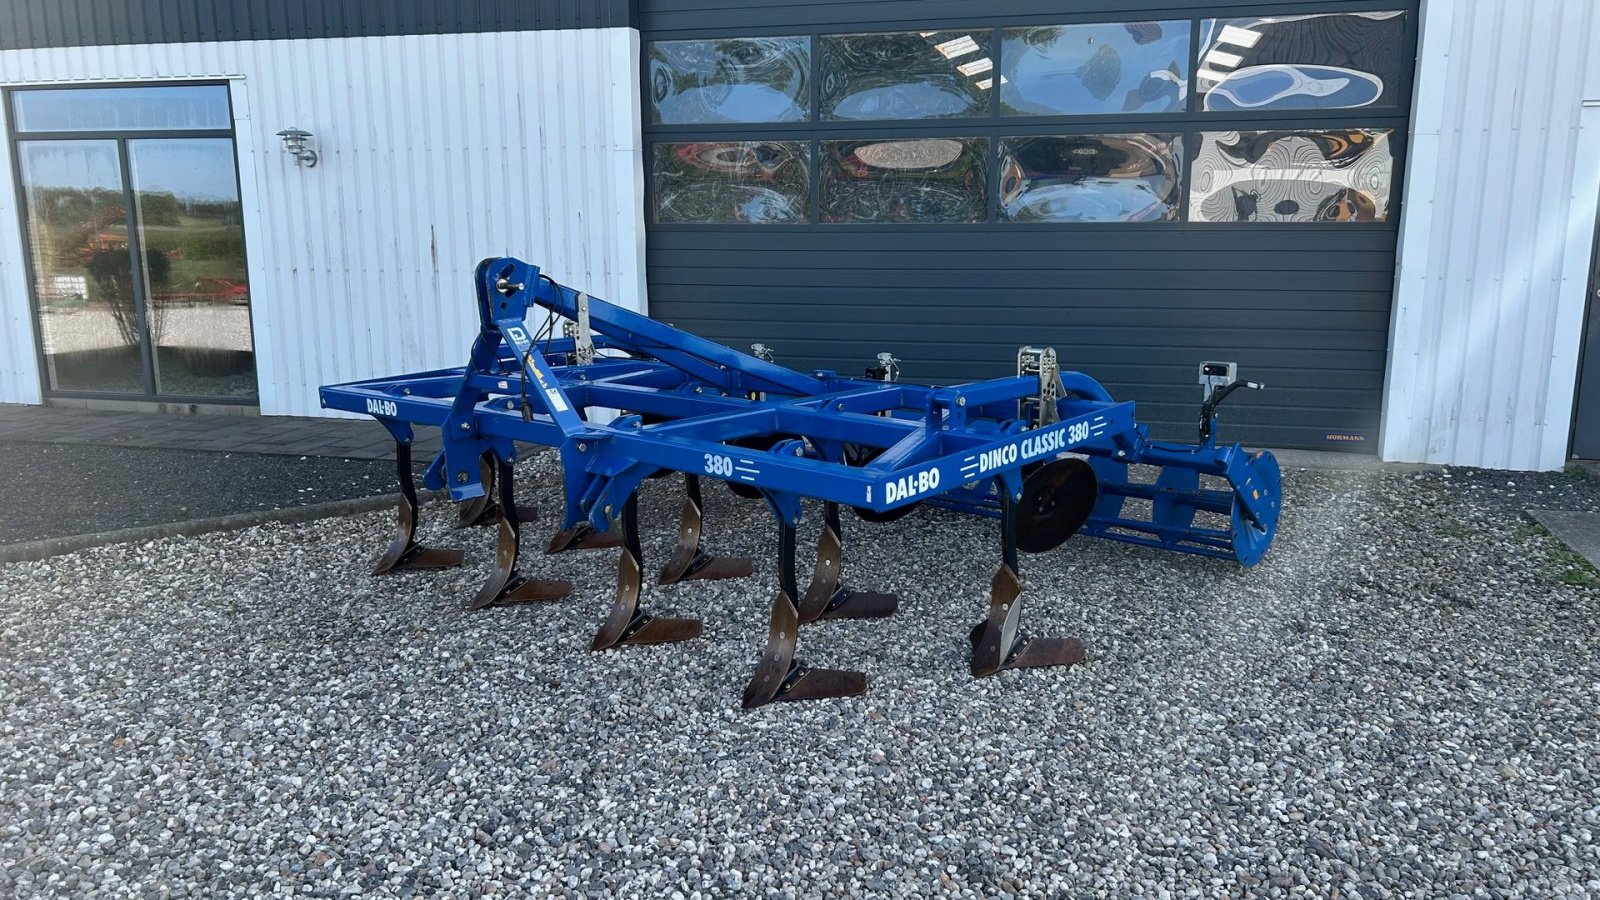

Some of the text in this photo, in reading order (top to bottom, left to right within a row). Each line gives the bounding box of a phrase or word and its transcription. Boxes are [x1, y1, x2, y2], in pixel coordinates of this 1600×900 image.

[704, 453, 733, 477] 380
[980, 421, 1089, 473] DINCO CLASSIC 380
